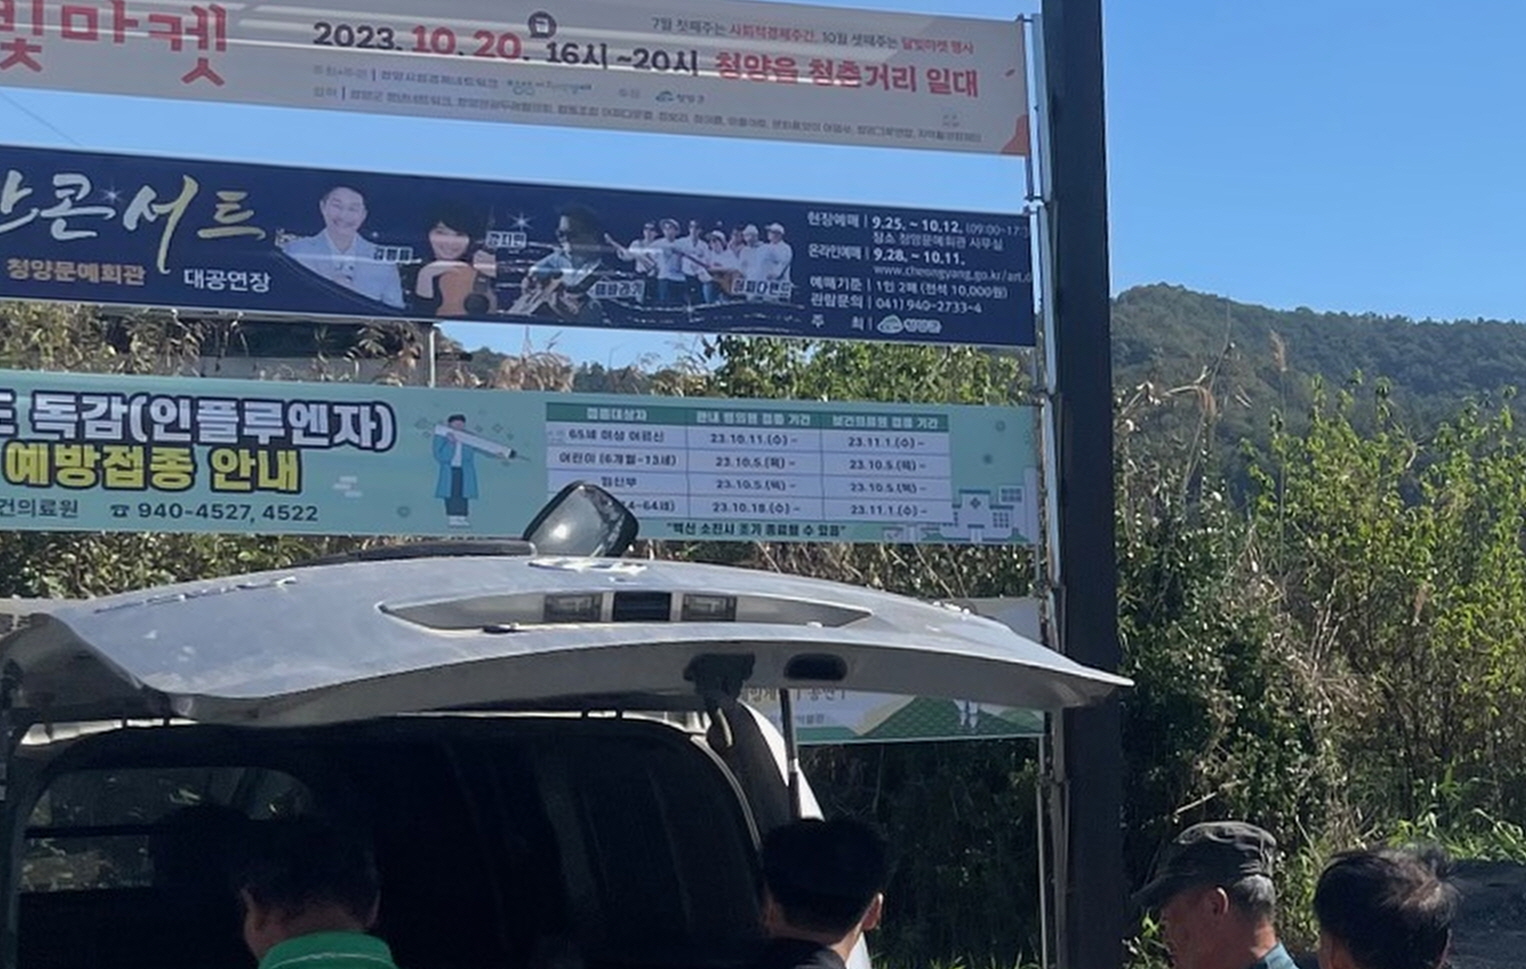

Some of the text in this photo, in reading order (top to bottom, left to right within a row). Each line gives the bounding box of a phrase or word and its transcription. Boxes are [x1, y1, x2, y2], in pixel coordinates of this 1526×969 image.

[313, 21, 403, 51] 2023.
[547, 42, 608, 70] 16시
[715, 50, 798, 83] 청양읍
[809, 58, 917, 93] 청춘거리
[926, 67, 979, 98] 일대
[807, 211, 860, 228] 현장예매
[872, 216, 906, 231] 9.25.
[922, 218, 963, 234] 10.12.
[923, 252, 966, 267] 10.11.
[183, 268, 271, 294] 대공연장
[809, 275, 863, 293] 예매기준
[810, 292, 864, 310] 관람문의
[31, 391, 397, 450] 독감(인플루엔자)
[4, 439, 304, 494] 예방접종 안내
[137, 502, 319, 524] 940-4527, 4522
